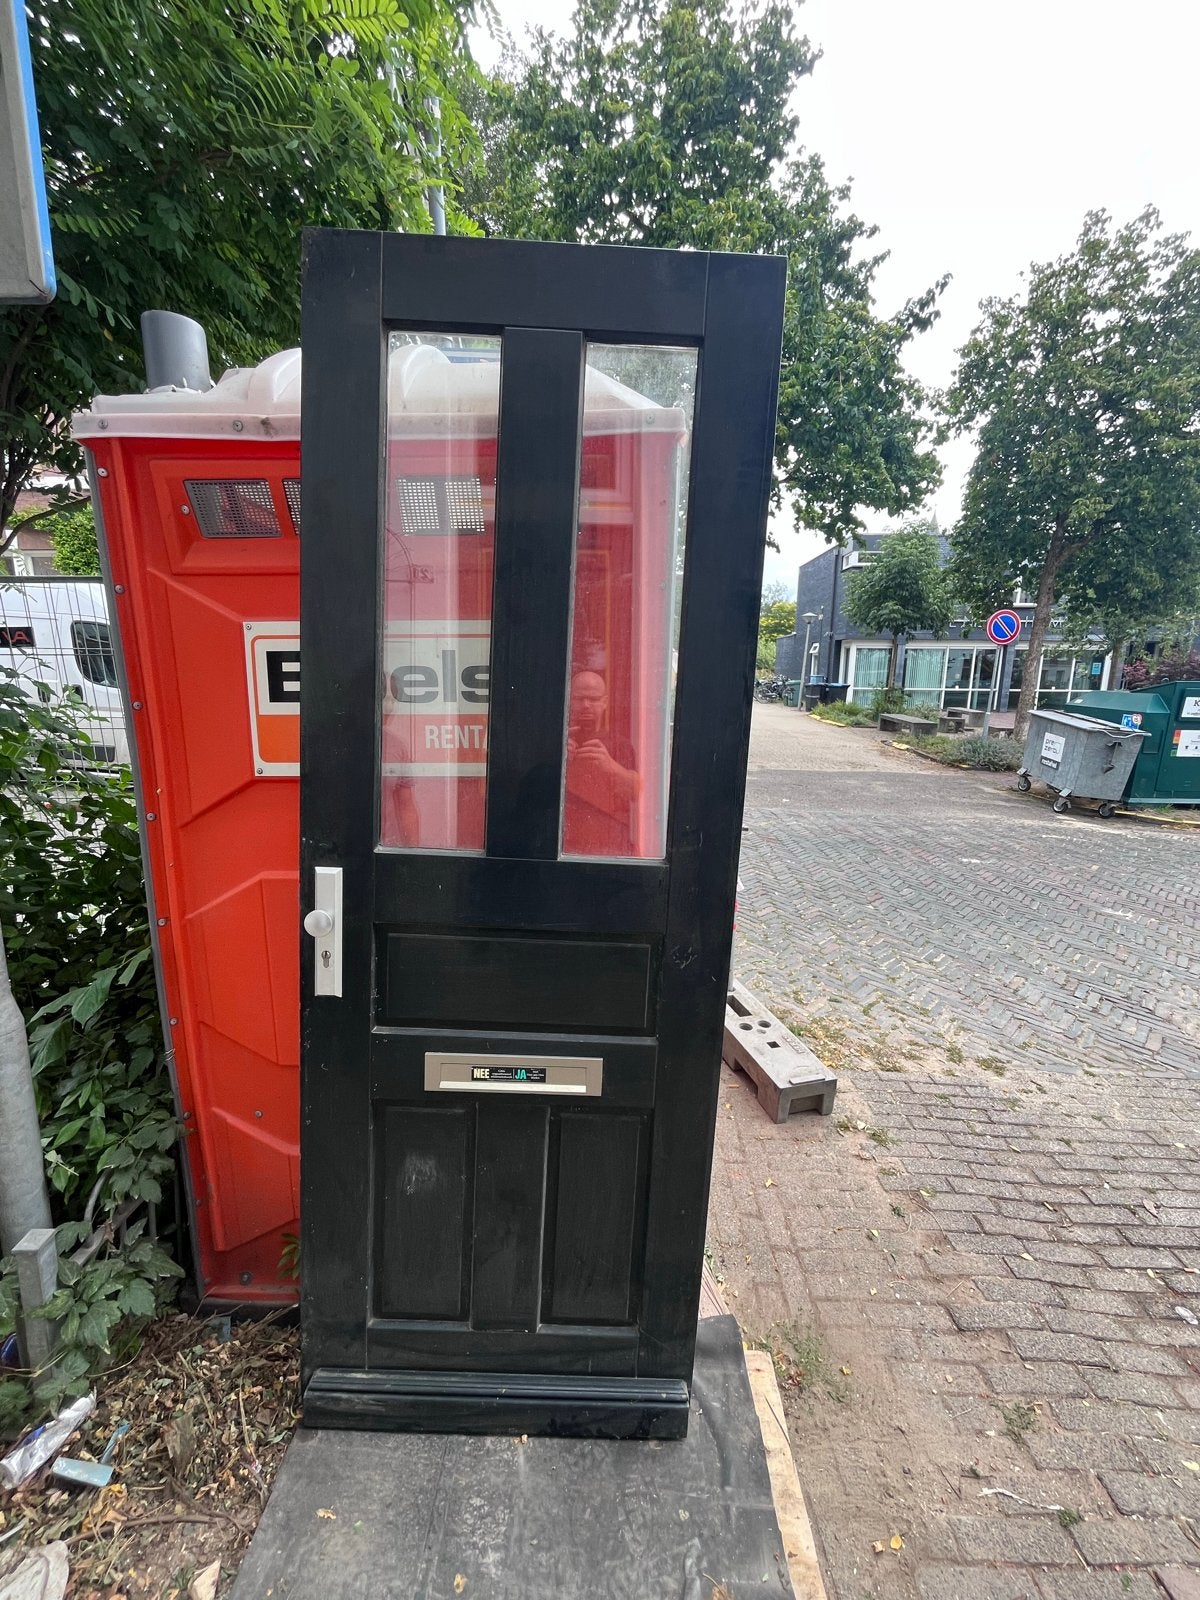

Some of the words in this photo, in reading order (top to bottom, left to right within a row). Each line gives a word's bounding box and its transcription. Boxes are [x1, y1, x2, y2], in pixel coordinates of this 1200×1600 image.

[424, 725, 487, 749] RENT
[473, 1068, 490, 1079] NEE
[515, 1069, 527, 1080] JA
